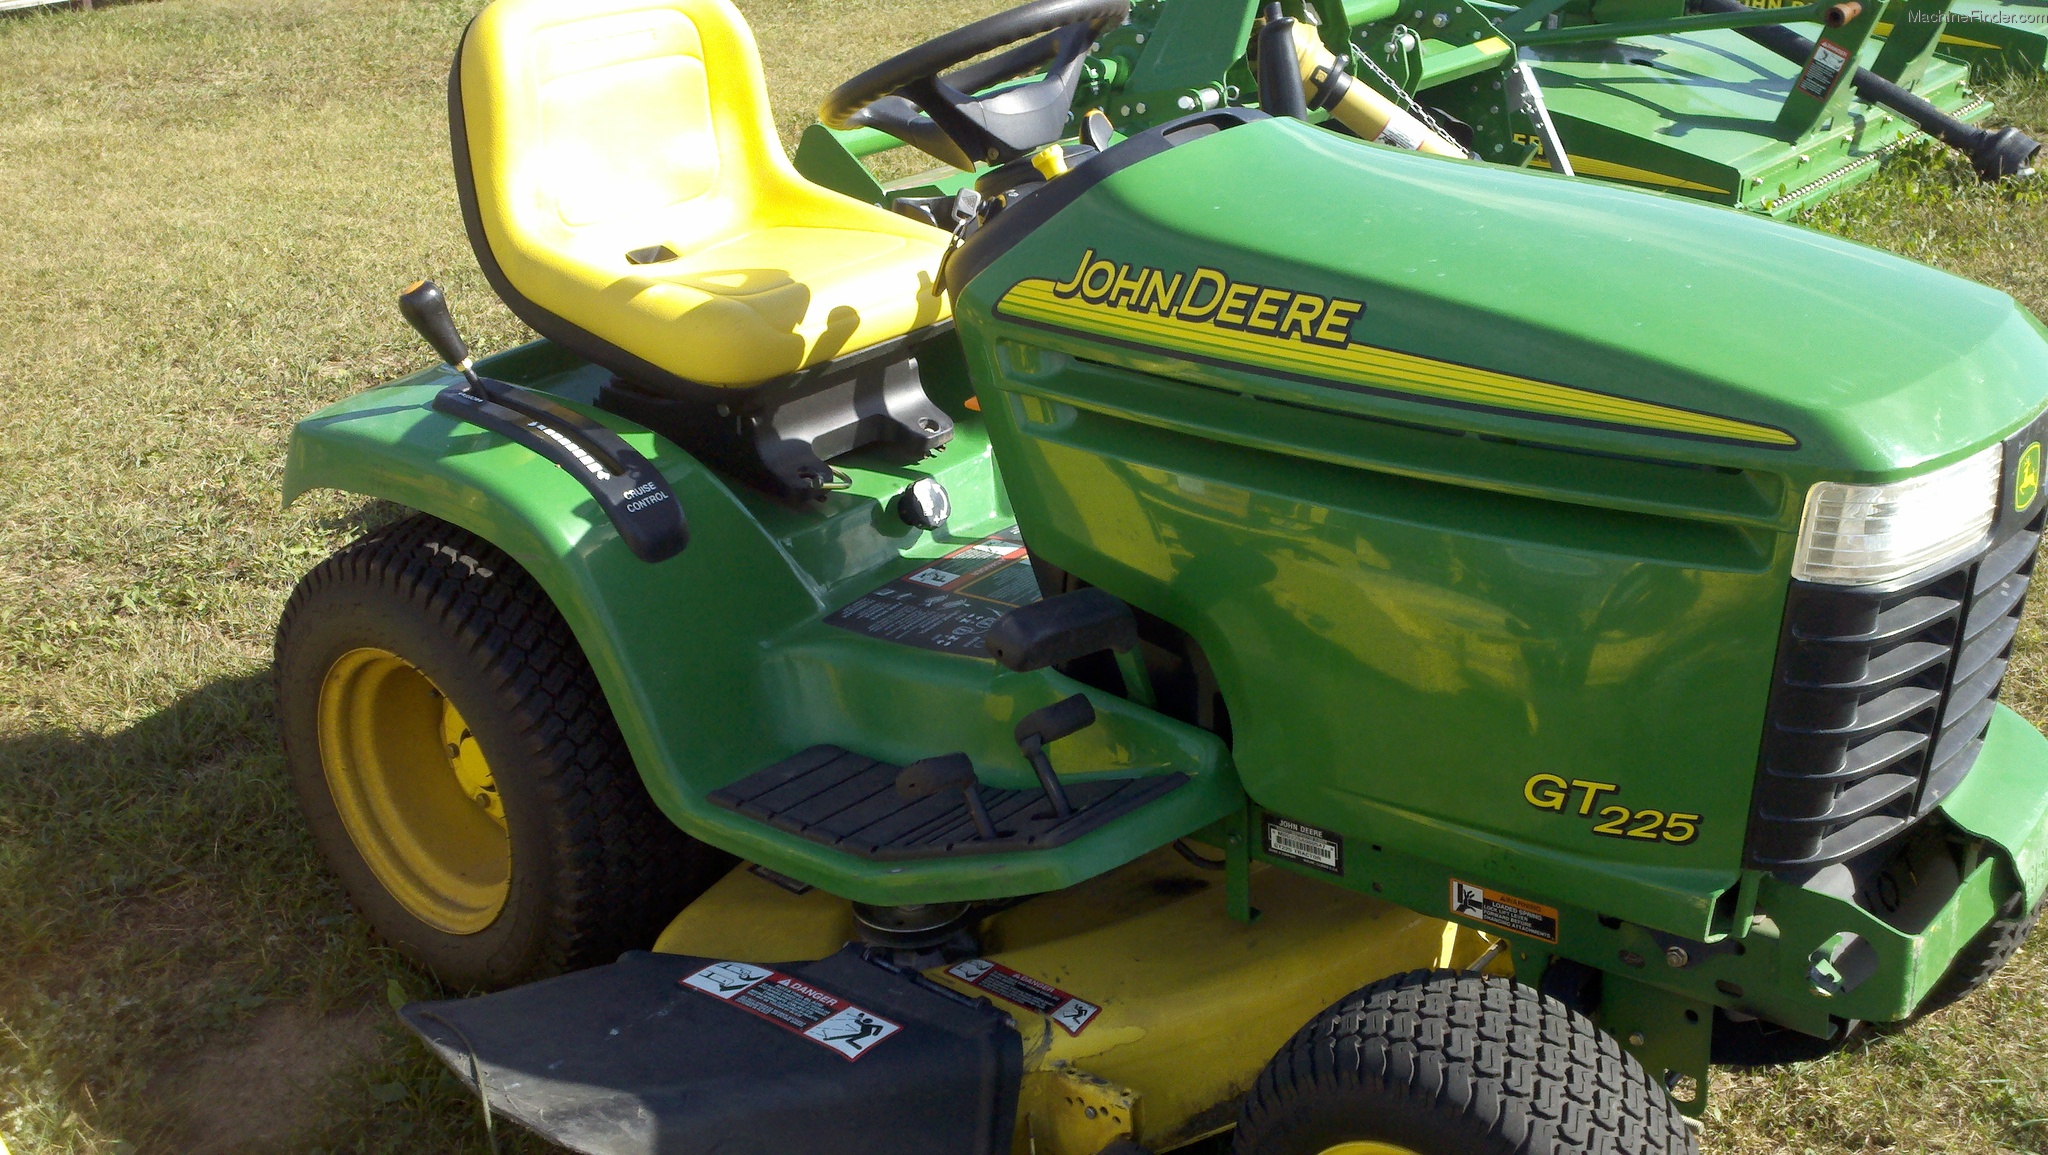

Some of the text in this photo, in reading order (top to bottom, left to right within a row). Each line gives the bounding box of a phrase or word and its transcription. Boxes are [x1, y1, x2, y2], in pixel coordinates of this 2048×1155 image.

[1053, 247, 1366, 350] JOHN DEERE
[623, 481, 657, 500] CRUISE
[626, 491, 669, 513] CONTROL
[1279, 820, 1298, 831] JOHN
[1300, 825, 1323, 839] DEERE
[1492, 901, 1543, 921] LOADED SPRING
[1510, 917, 1532, 927] BEFORE
[1511, 922, 1551, 938] ATTACHMENTS
[1020, 975, 1055, 993] DANGER
[790, 982, 838, 1007] DANGER
